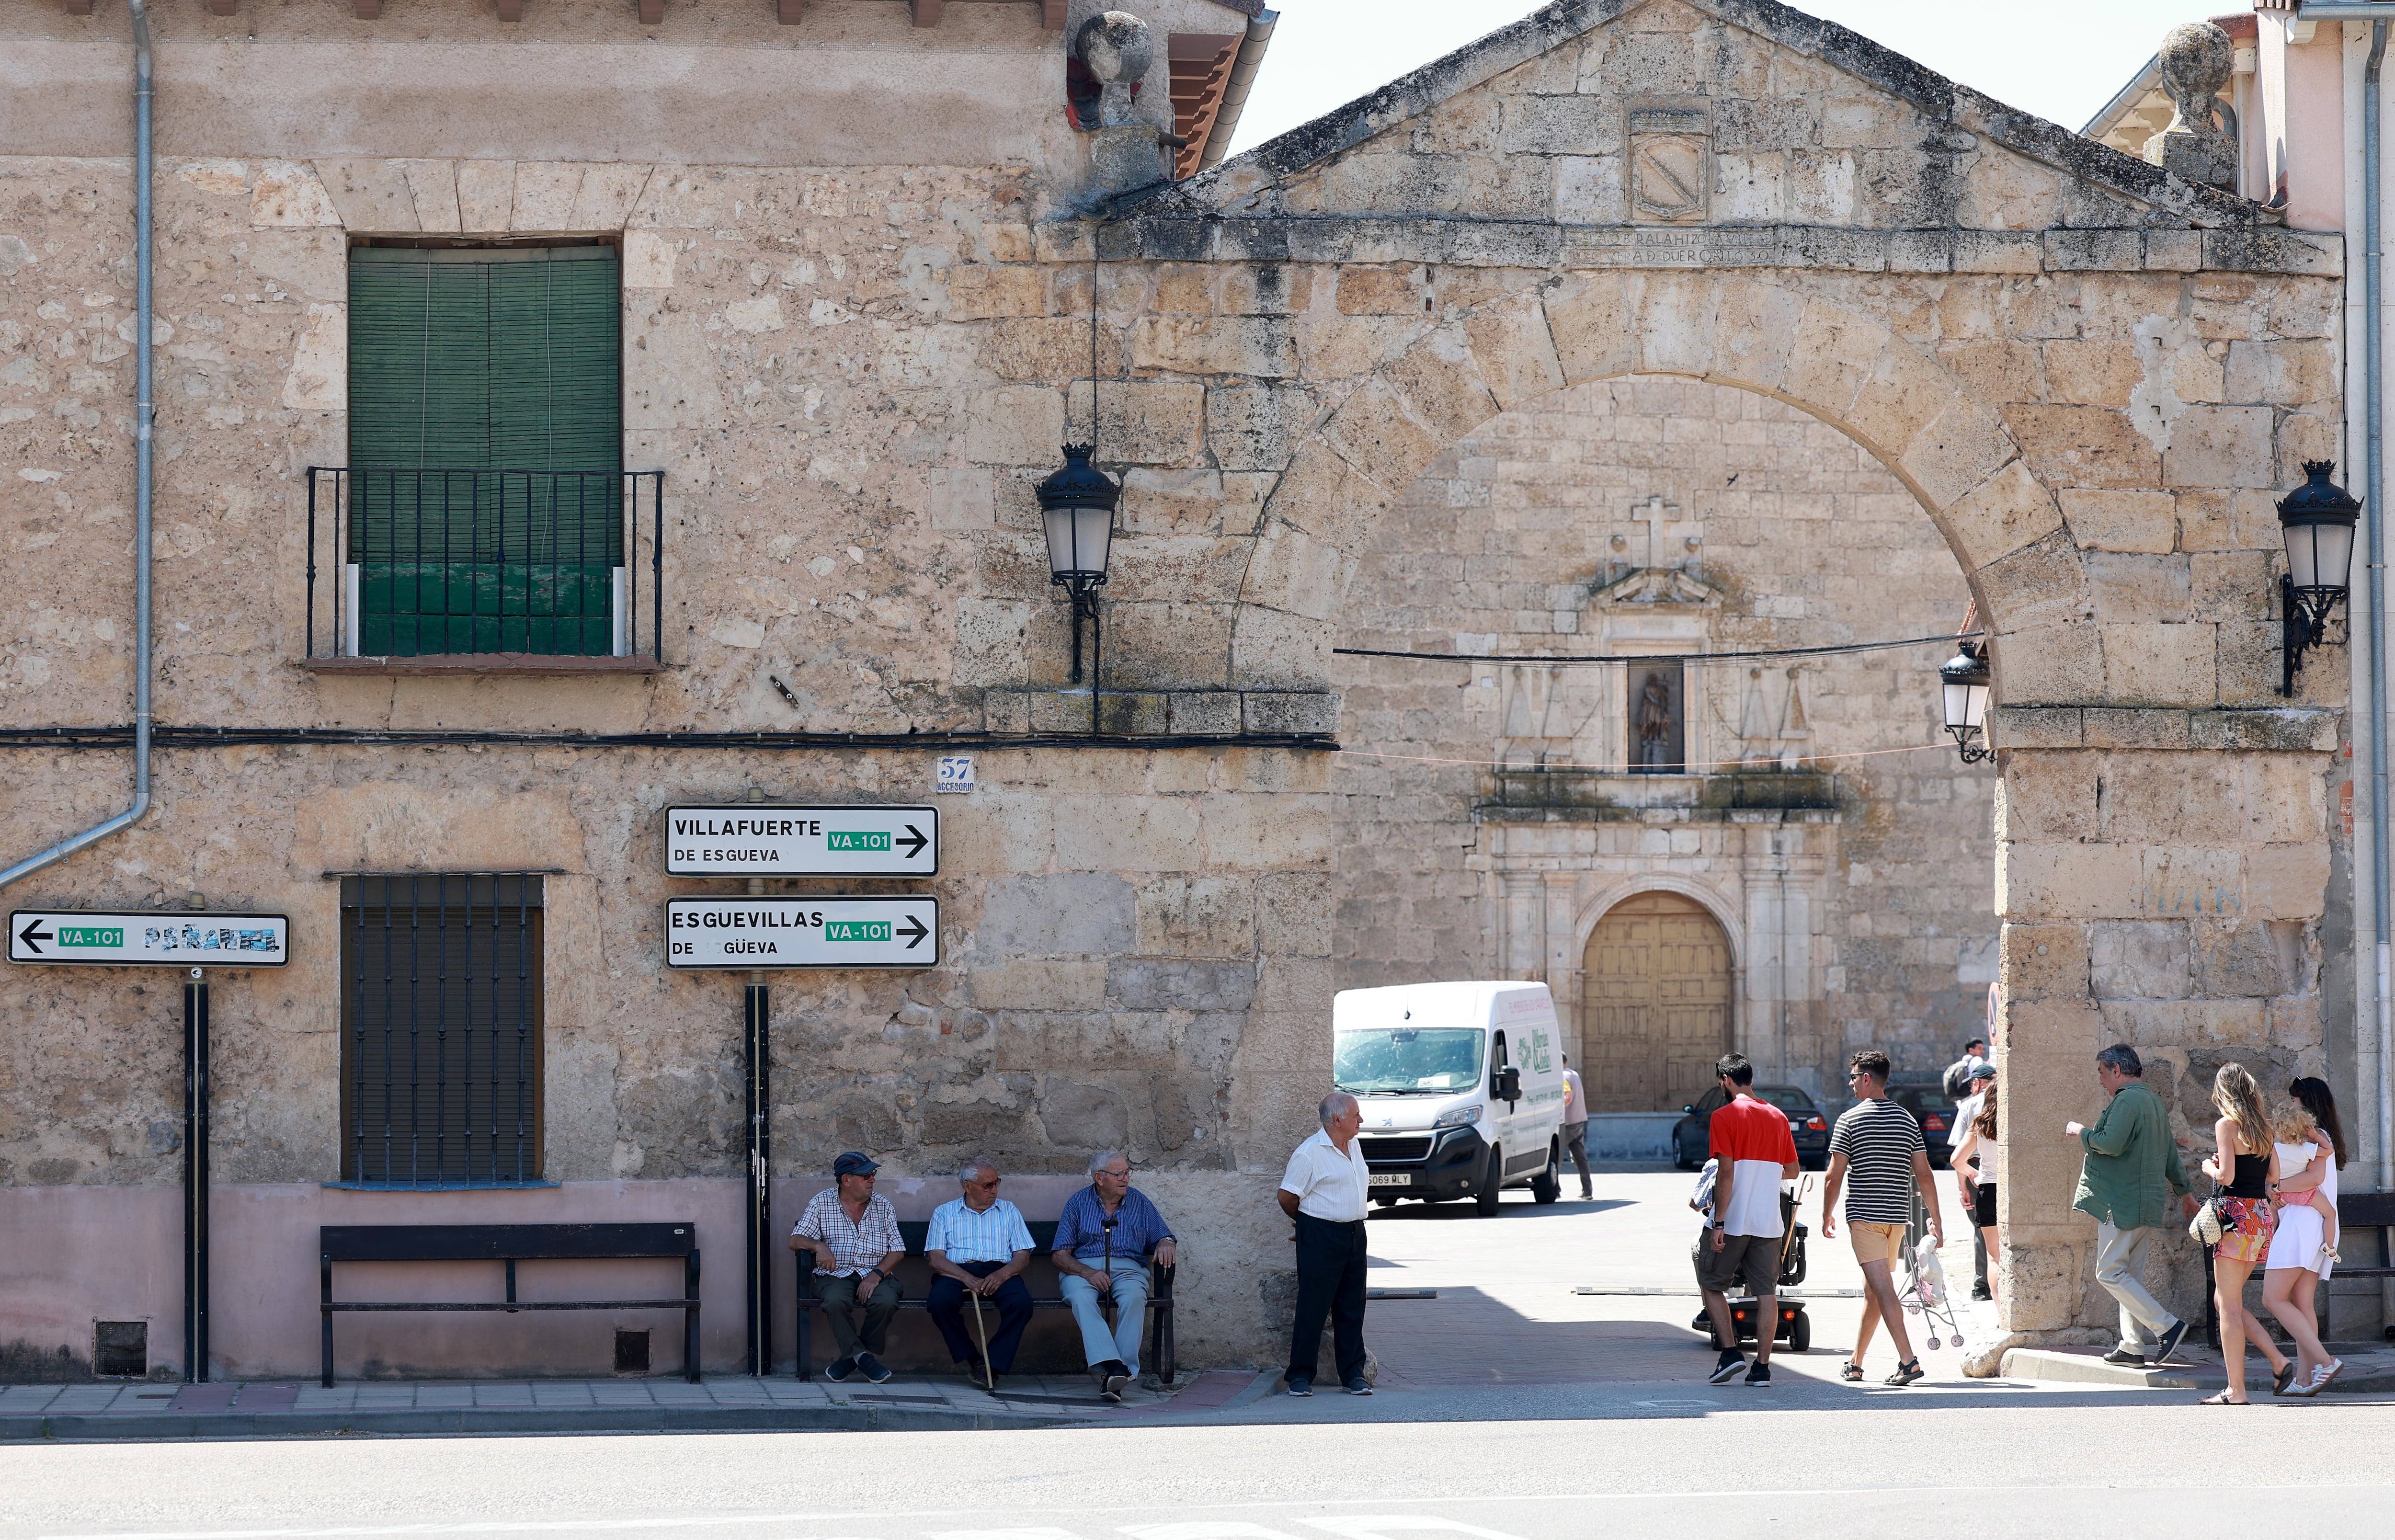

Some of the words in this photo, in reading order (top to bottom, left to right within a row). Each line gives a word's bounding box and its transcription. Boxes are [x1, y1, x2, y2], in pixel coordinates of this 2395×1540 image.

[941, 758, 970, 779] 37
[675, 820, 821, 836] VILLAFUERTE
[831, 834, 889, 848] VA-101
[674, 849, 696, 861] DE
[703, 849, 779, 862] ESGUEVA
[672, 911, 823, 928] ESGUEVILLAS
[62, 930, 121, 945] VA-101
[829, 925, 889, 939] VA-101
[673, 942, 693, 954] DE
[1392, 1175, 1408, 1184] MLY
